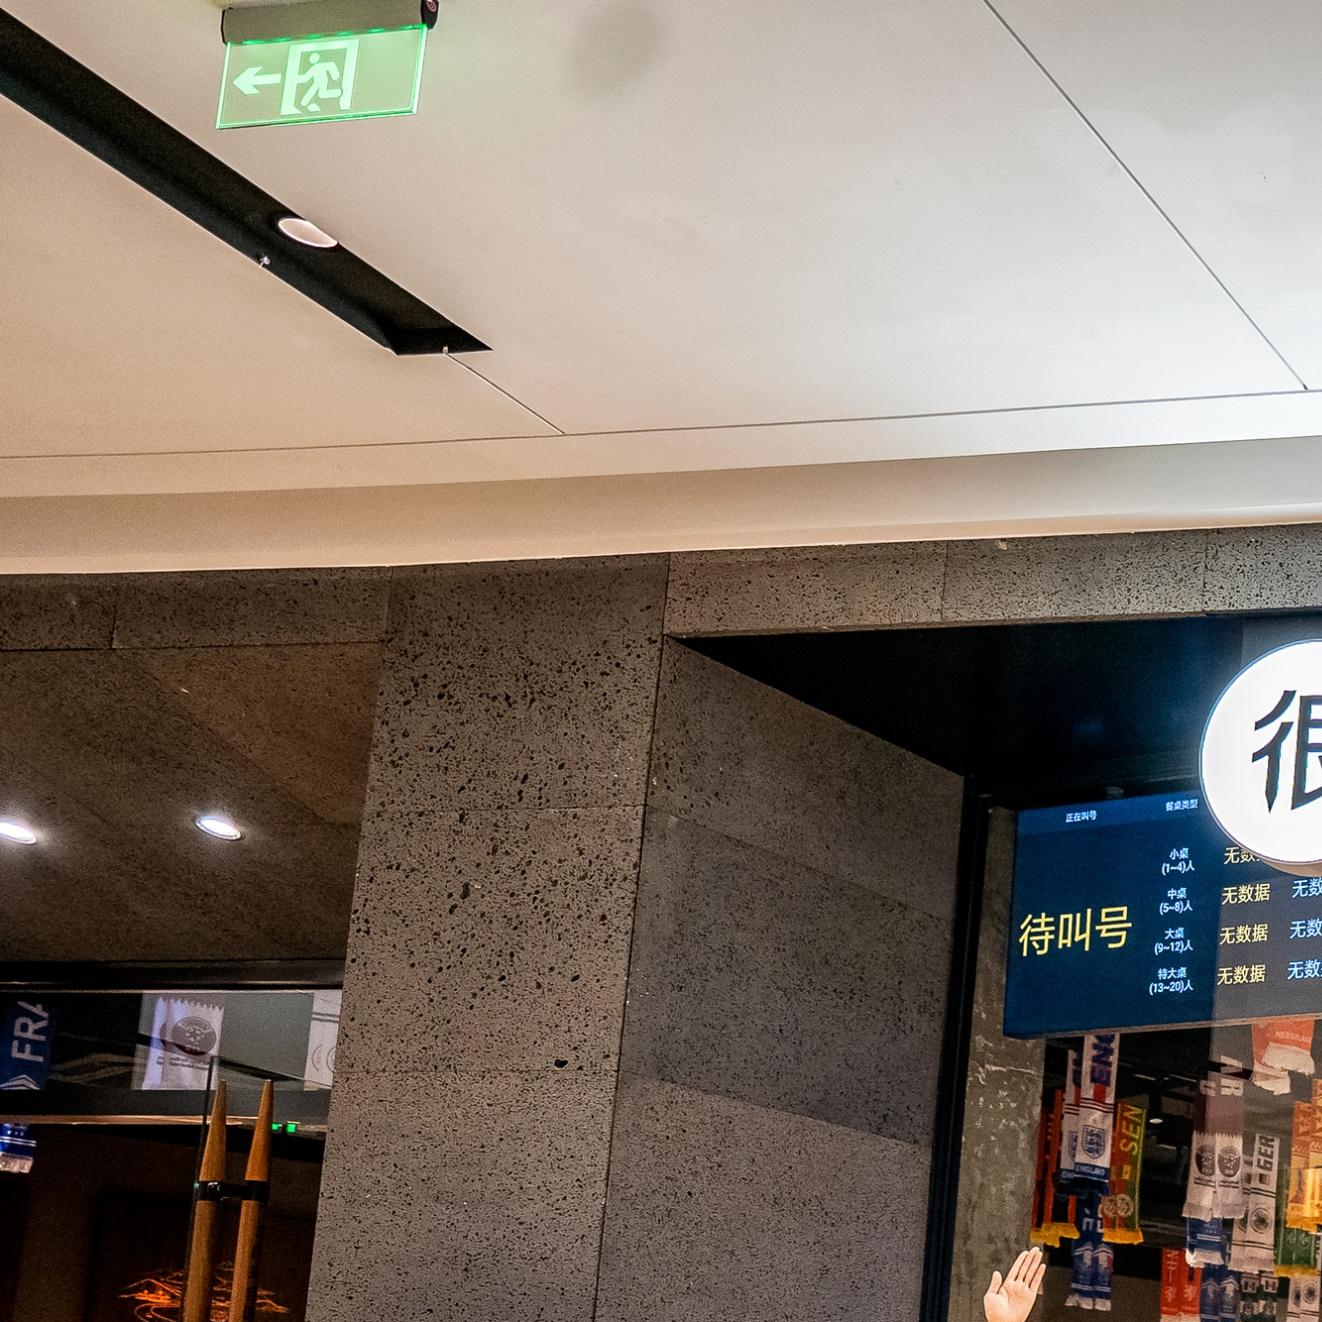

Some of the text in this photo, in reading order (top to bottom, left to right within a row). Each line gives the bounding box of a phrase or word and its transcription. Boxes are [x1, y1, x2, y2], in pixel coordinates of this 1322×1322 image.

[1169, 848, 1189, 860] 小桌
[1224, 846, 1263, 865] 无数
[1167, 888, 1187, 900] 中桌
[1222, 884, 1271, 905] 无数据
[1018, 906, 1132, 957] 待叫号
[1164, 928, 1185, 940] 大桌
[1219, 924, 1268, 945] 无数据
[1217, 965, 1266, 985] 无数据
